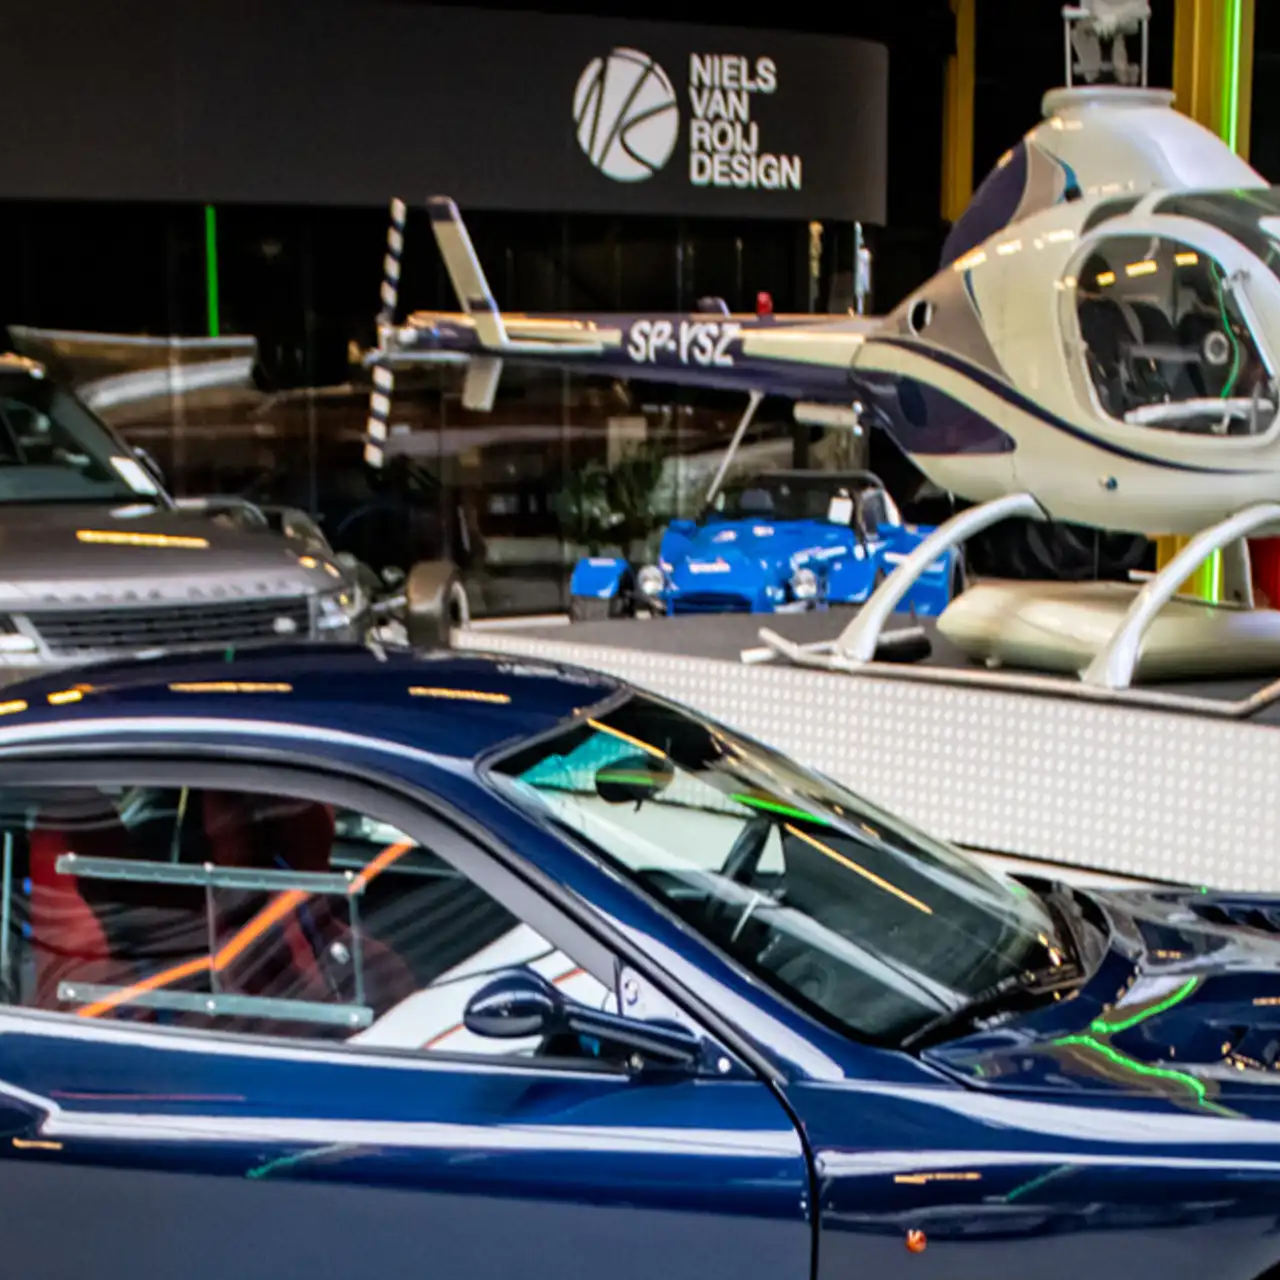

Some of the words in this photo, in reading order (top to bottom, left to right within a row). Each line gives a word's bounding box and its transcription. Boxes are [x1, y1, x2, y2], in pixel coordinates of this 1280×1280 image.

[689, 52, 777, 94] NIELS
[689, 86, 749, 123] VAN
[689, 118, 759, 153] ROIJ
[689, 151, 802, 191] DESIGN
